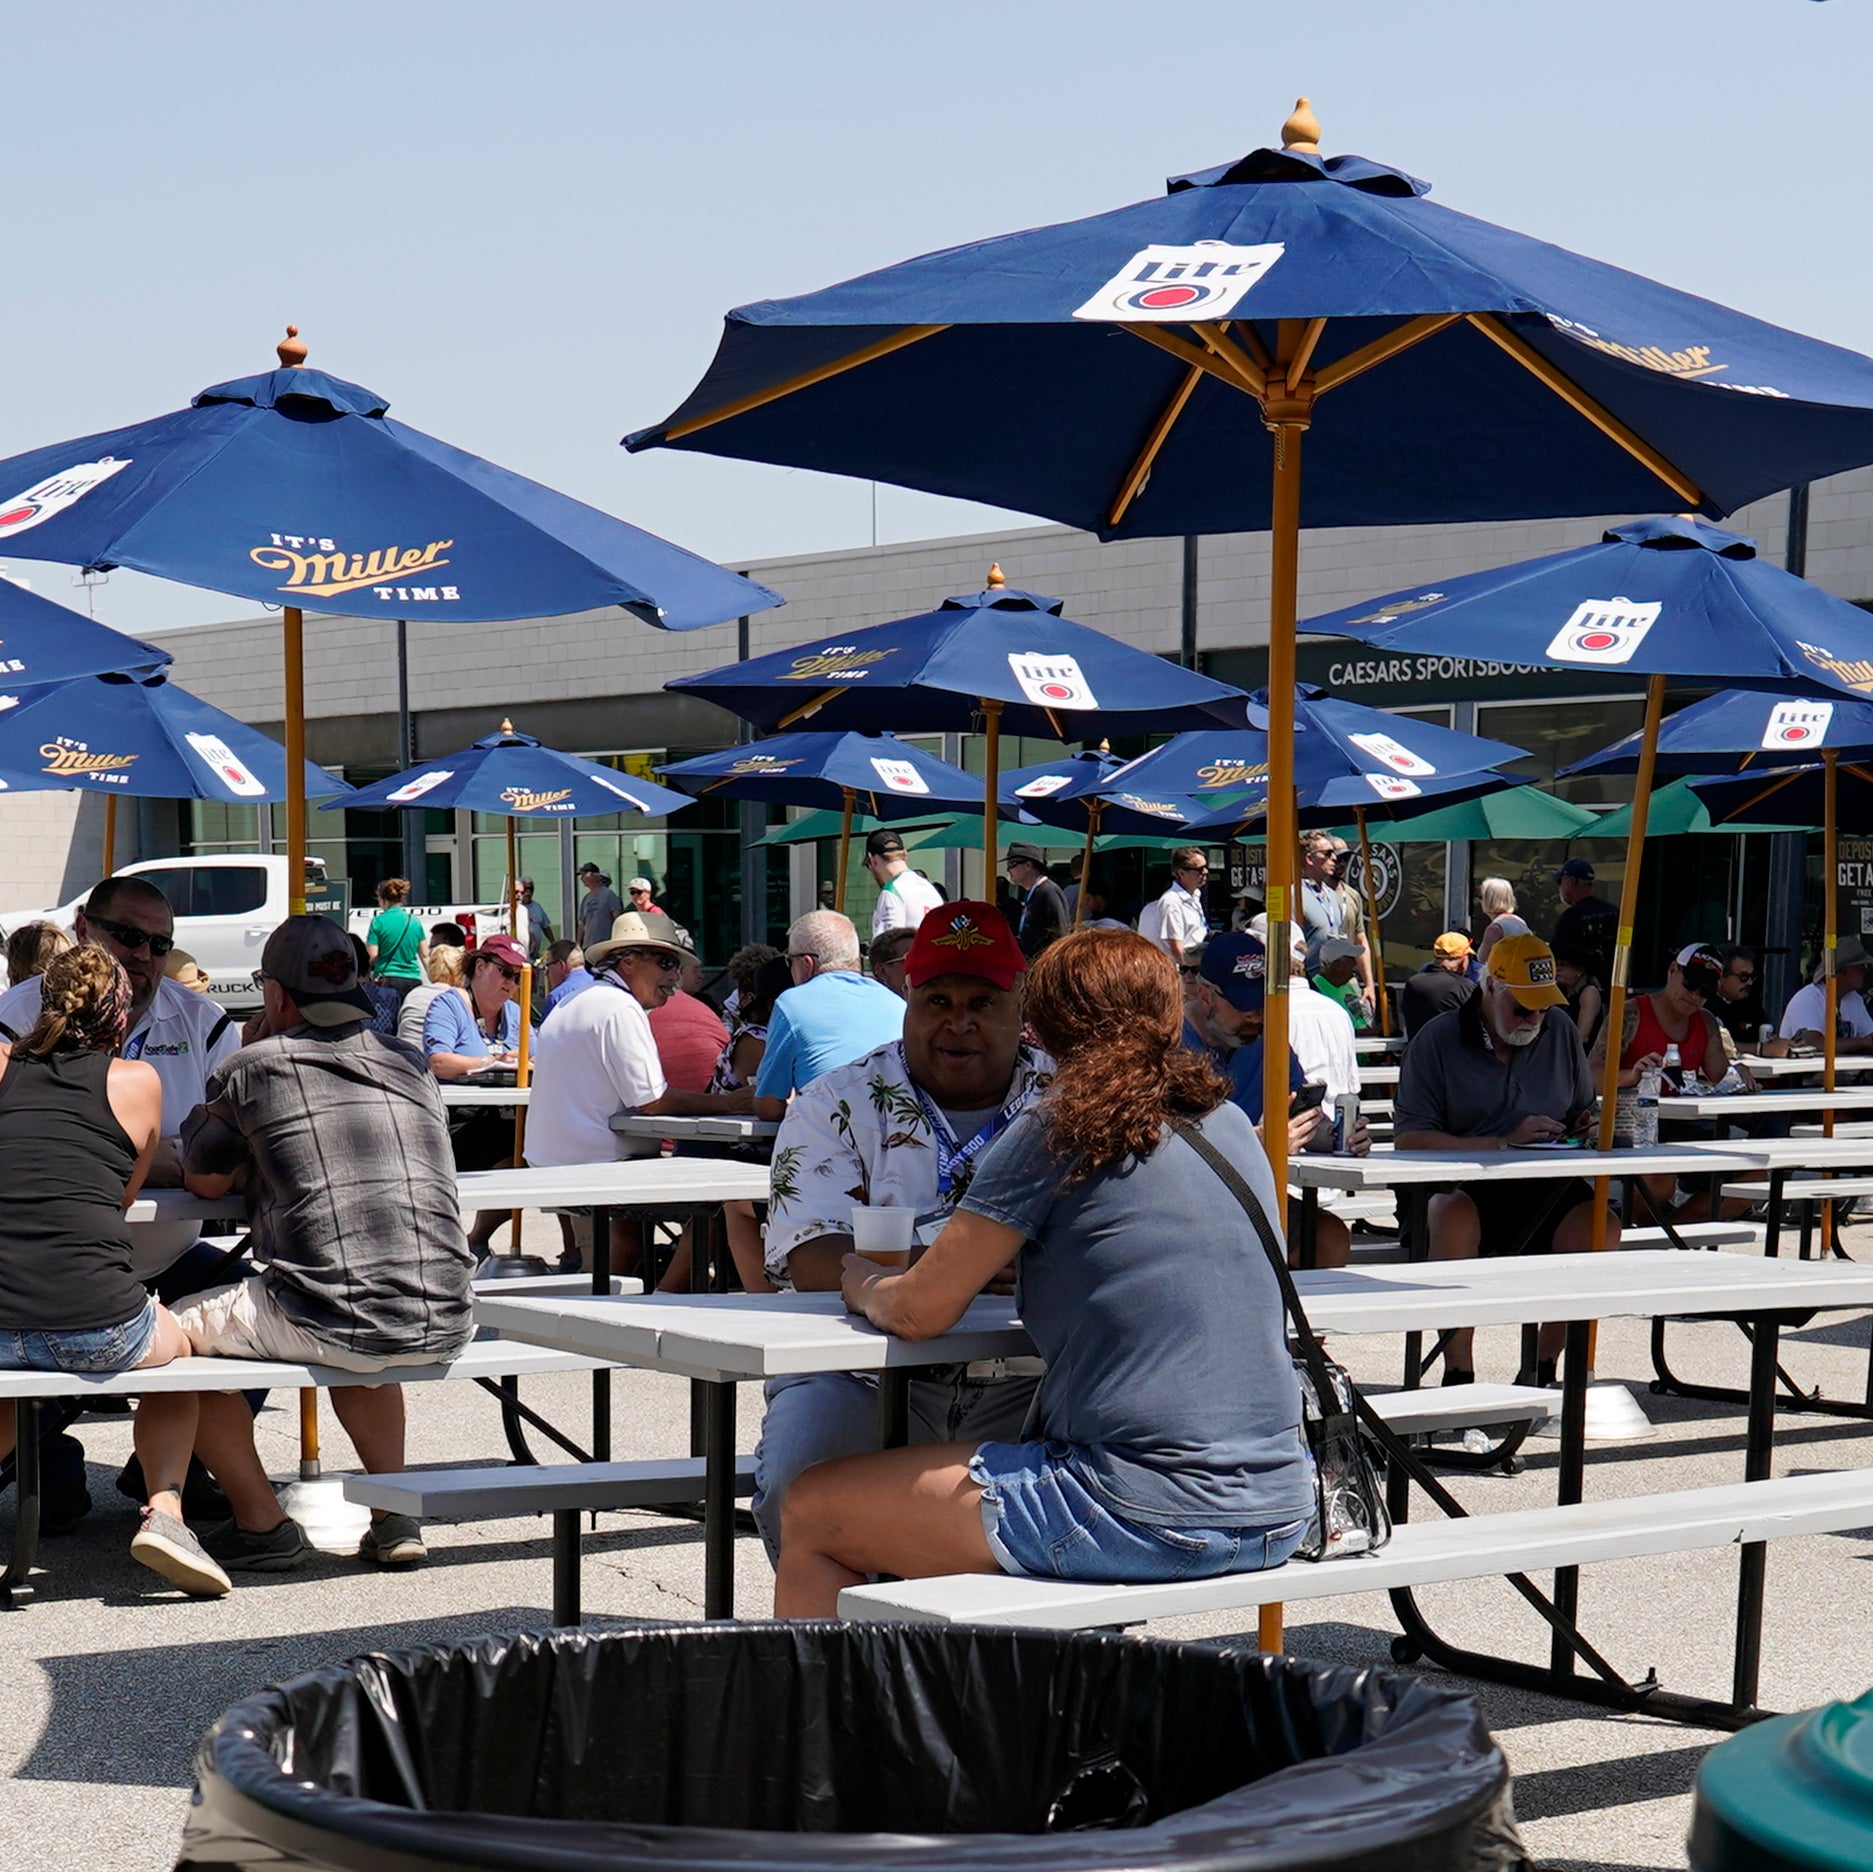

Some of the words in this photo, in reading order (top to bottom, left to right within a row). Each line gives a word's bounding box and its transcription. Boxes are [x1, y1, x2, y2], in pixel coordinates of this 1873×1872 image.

[1131, 261, 1262, 284] Lite
[270, 532, 336, 552] IT'S
[249, 538, 455, 598] Miller
[373, 585, 461, 601] TIME
[1577, 612, 1650, 630] Lite
[826, 670, 870, 681] TIME
[1020, 663, 1075, 682] Lite
[1328, 660, 1411, 687] CAESARS
[1776, 711, 1826, 725] Lite
[55, 735, 89, 750] IT'S
[38, 743, 140, 776] Miller
[1214, 758, 1246, 767] IT'S
[89, 771, 130, 785] TIME
[1197, 763, 1268, 788] Mill
[499, 788, 573, 812] Miller
[1837, 862, 1864, 887] GET
[205, 982, 256, 994] RUCK
[963, 1134, 986, 1156] 500
